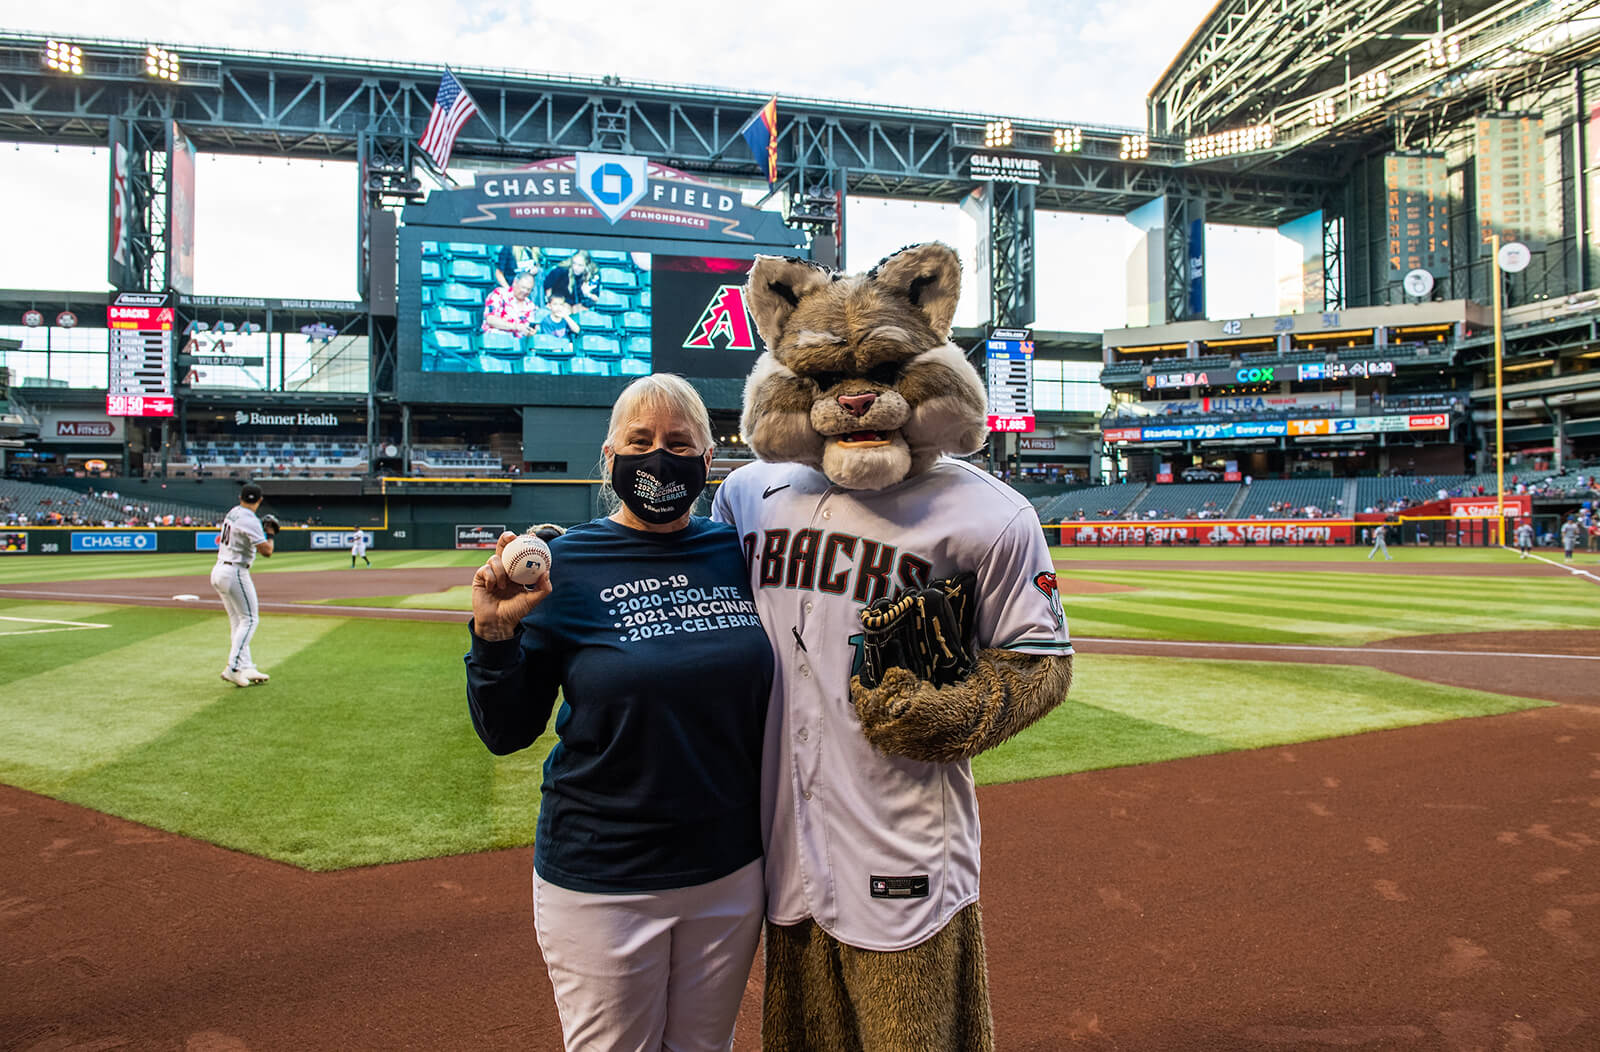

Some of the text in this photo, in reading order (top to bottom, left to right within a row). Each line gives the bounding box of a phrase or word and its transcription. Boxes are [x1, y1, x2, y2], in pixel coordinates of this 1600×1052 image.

[970, 154, 1040, 171] GILA RIVER
[484, 179, 734, 212] CHASE FIELD
[515, 207, 705, 227] HOME OF THE DIAMONDBACKS
[180, 296, 265, 307] NL WEST CHAMPIONS
[282, 300, 355, 310] WORLD CHAMPIONS
[110, 308, 149, 319] D-BACKS
[1223, 320, 1241, 334] 42
[988, 341, 1006, 350] METS
[198, 357, 244, 366] WILD CARD
[1236, 367, 1274, 383] COX
[1213, 397, 1264, 409] ULTRA
[250, 412, 339, 426] Banner Health
[77, 426, 110, 435] FITNESS
[1143, 429, 1182, 439] Starting
[1184, 428, 1194, 436] at
[1236, 425, 1264, 435] Every
[1266, 424, 1285, 434] day
[1102, 526, 1144, 541] State
[1235, 525, 1331, 541] State Farm
[82, 536, 131, 548] CHASE
[600, 574, 689, 603] COVID-19
[617, 586, 741, 615] 2020-ISOLATE
